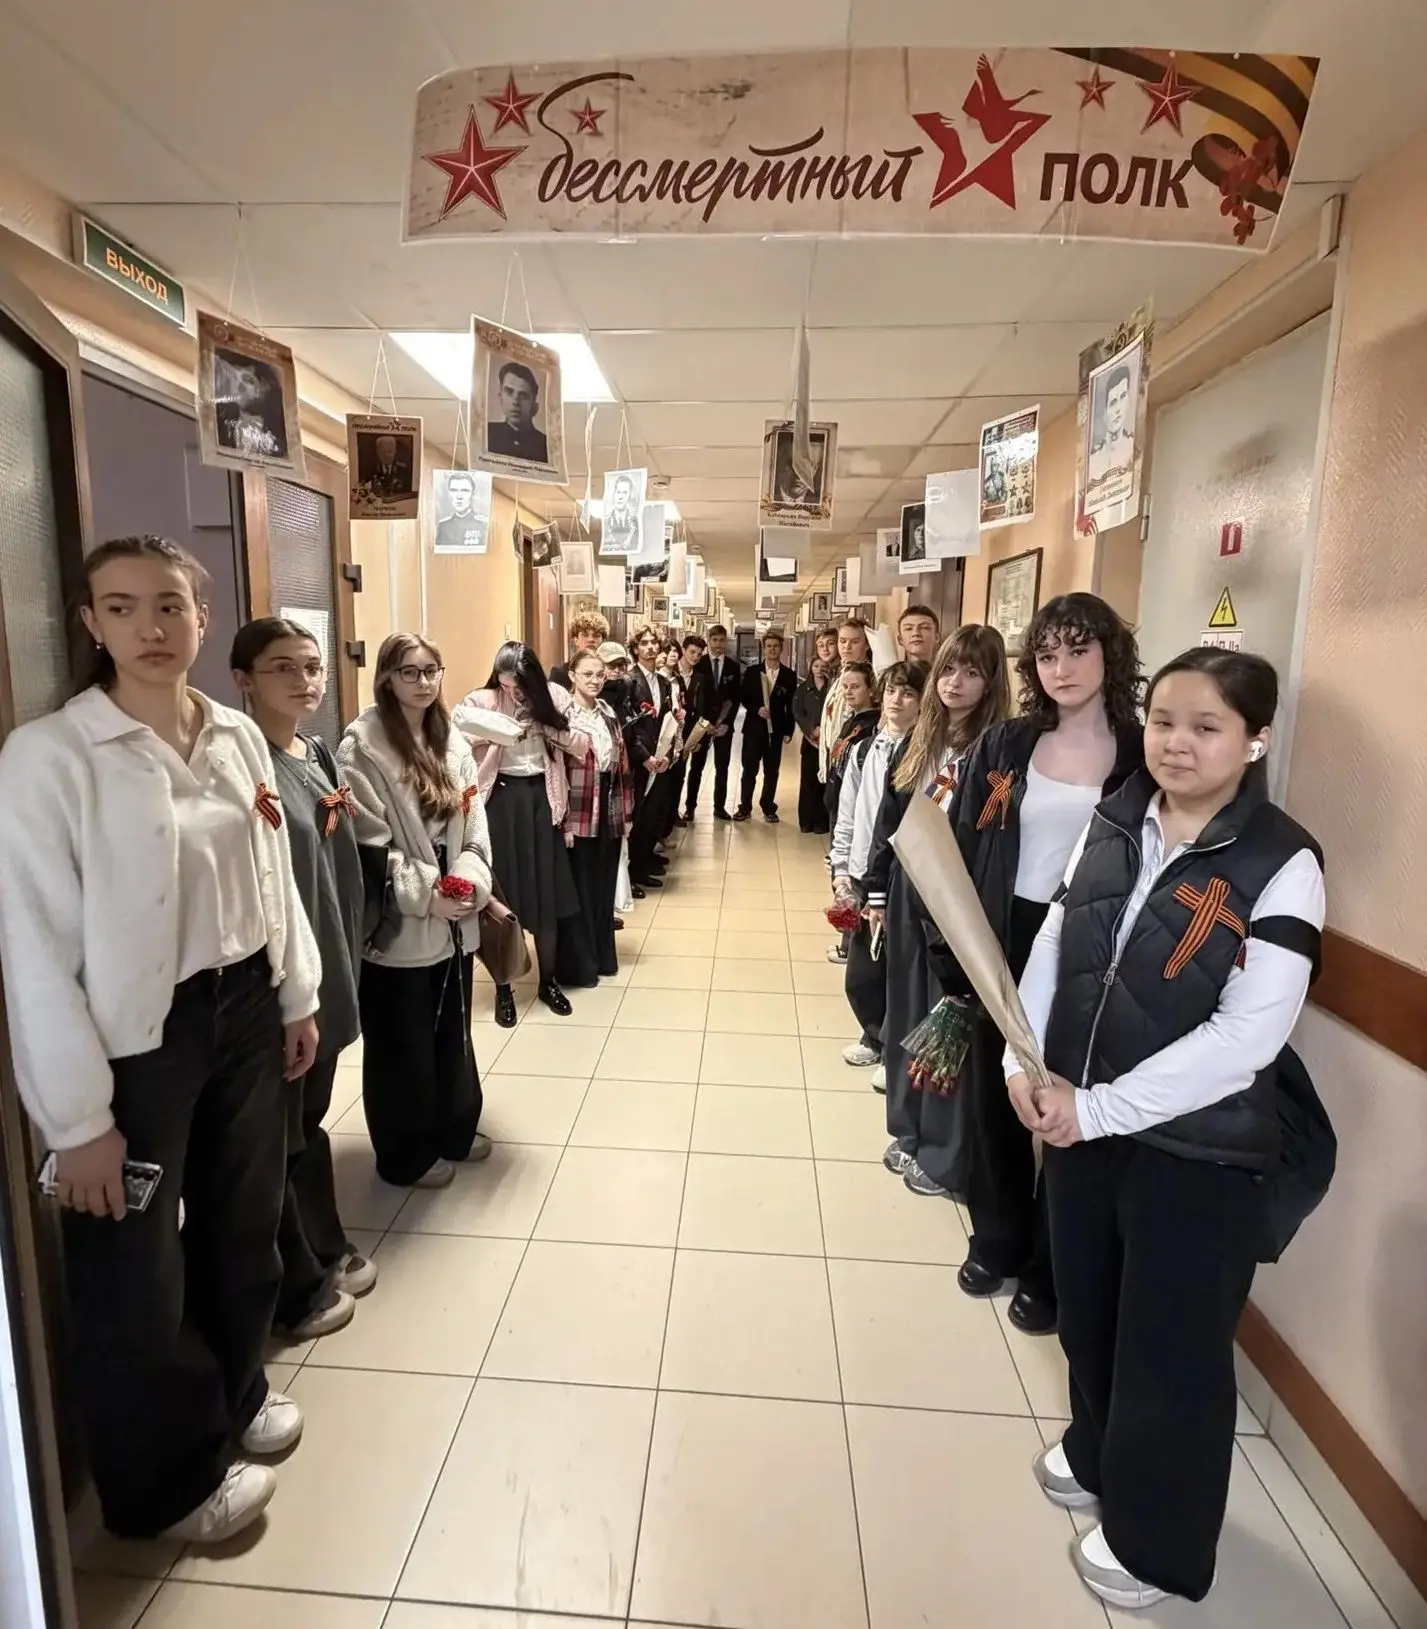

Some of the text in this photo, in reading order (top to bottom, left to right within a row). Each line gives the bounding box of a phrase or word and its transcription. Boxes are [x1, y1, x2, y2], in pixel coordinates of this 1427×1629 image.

[537, 71, 1193, 223] бессмертный ПОЛК
[105, 247, 168, 306] ВЫХОД
